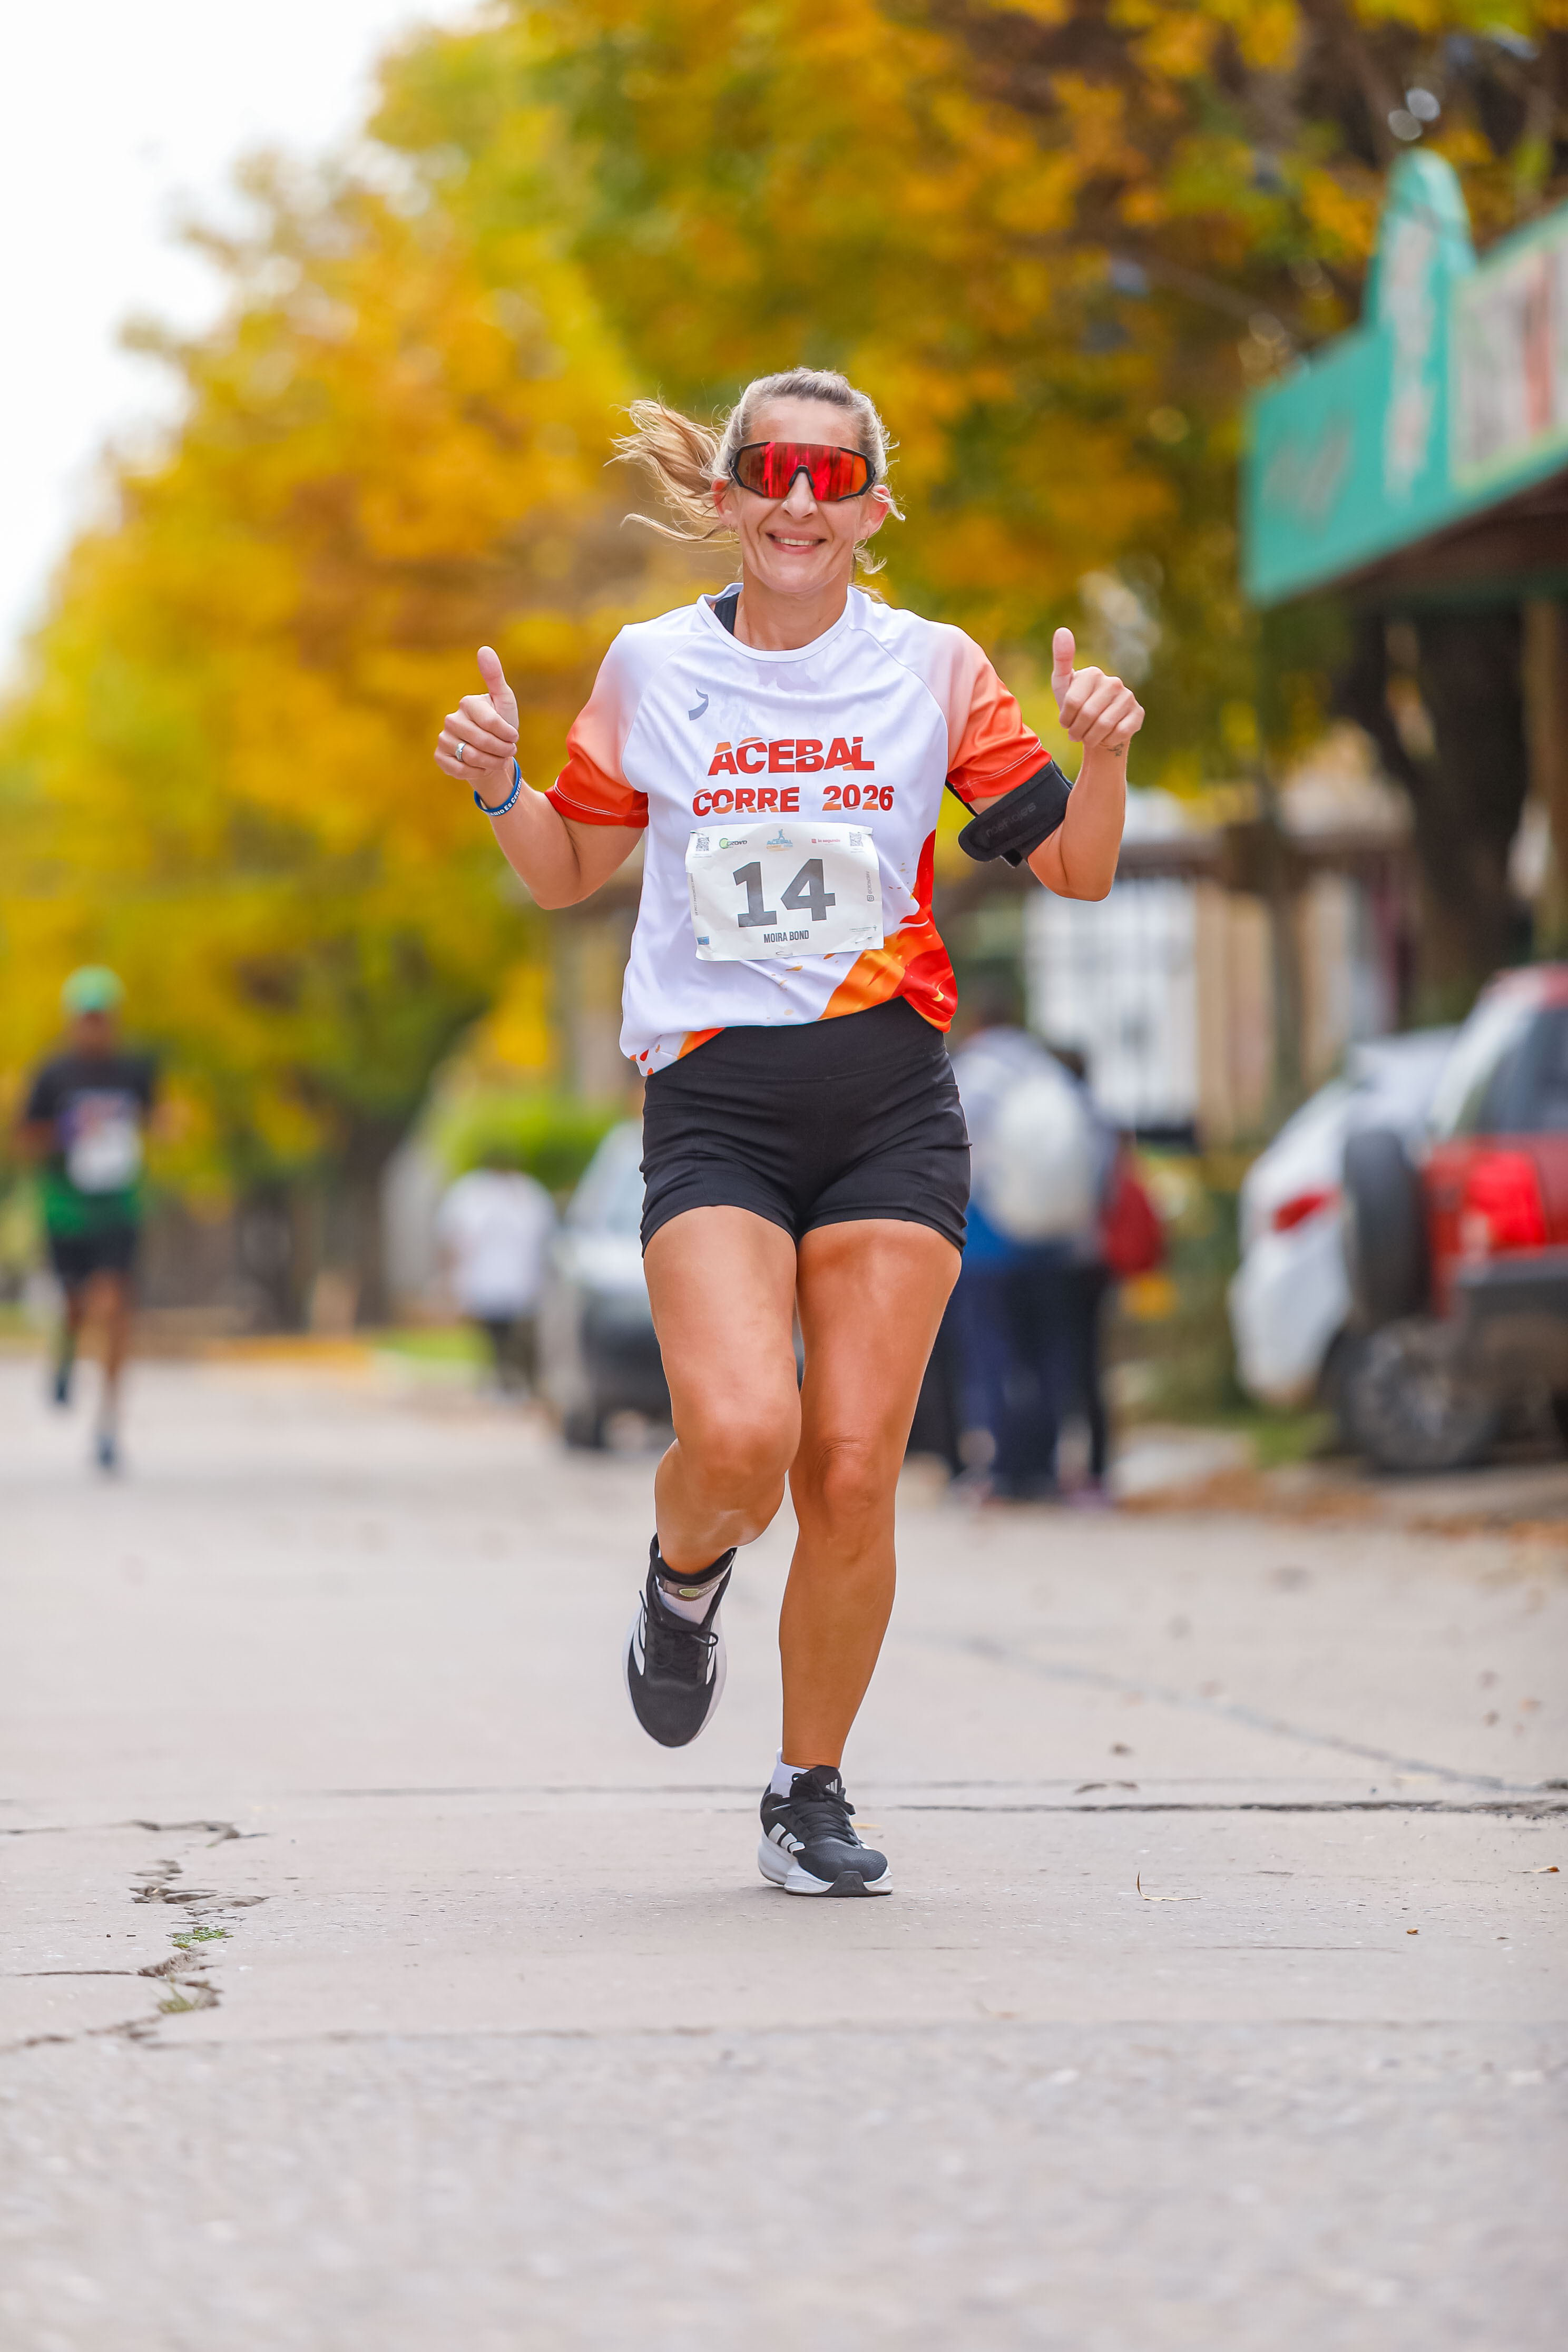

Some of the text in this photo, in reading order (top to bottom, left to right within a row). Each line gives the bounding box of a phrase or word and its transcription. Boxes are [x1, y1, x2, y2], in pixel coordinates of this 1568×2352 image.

[708, 737, 875, 776] ACEBAL
[692, 784, 895, 816] CORRE 2026
[733, 858, 836, 927] 14
[763, 930, 809, 943] MOIRA BOND
